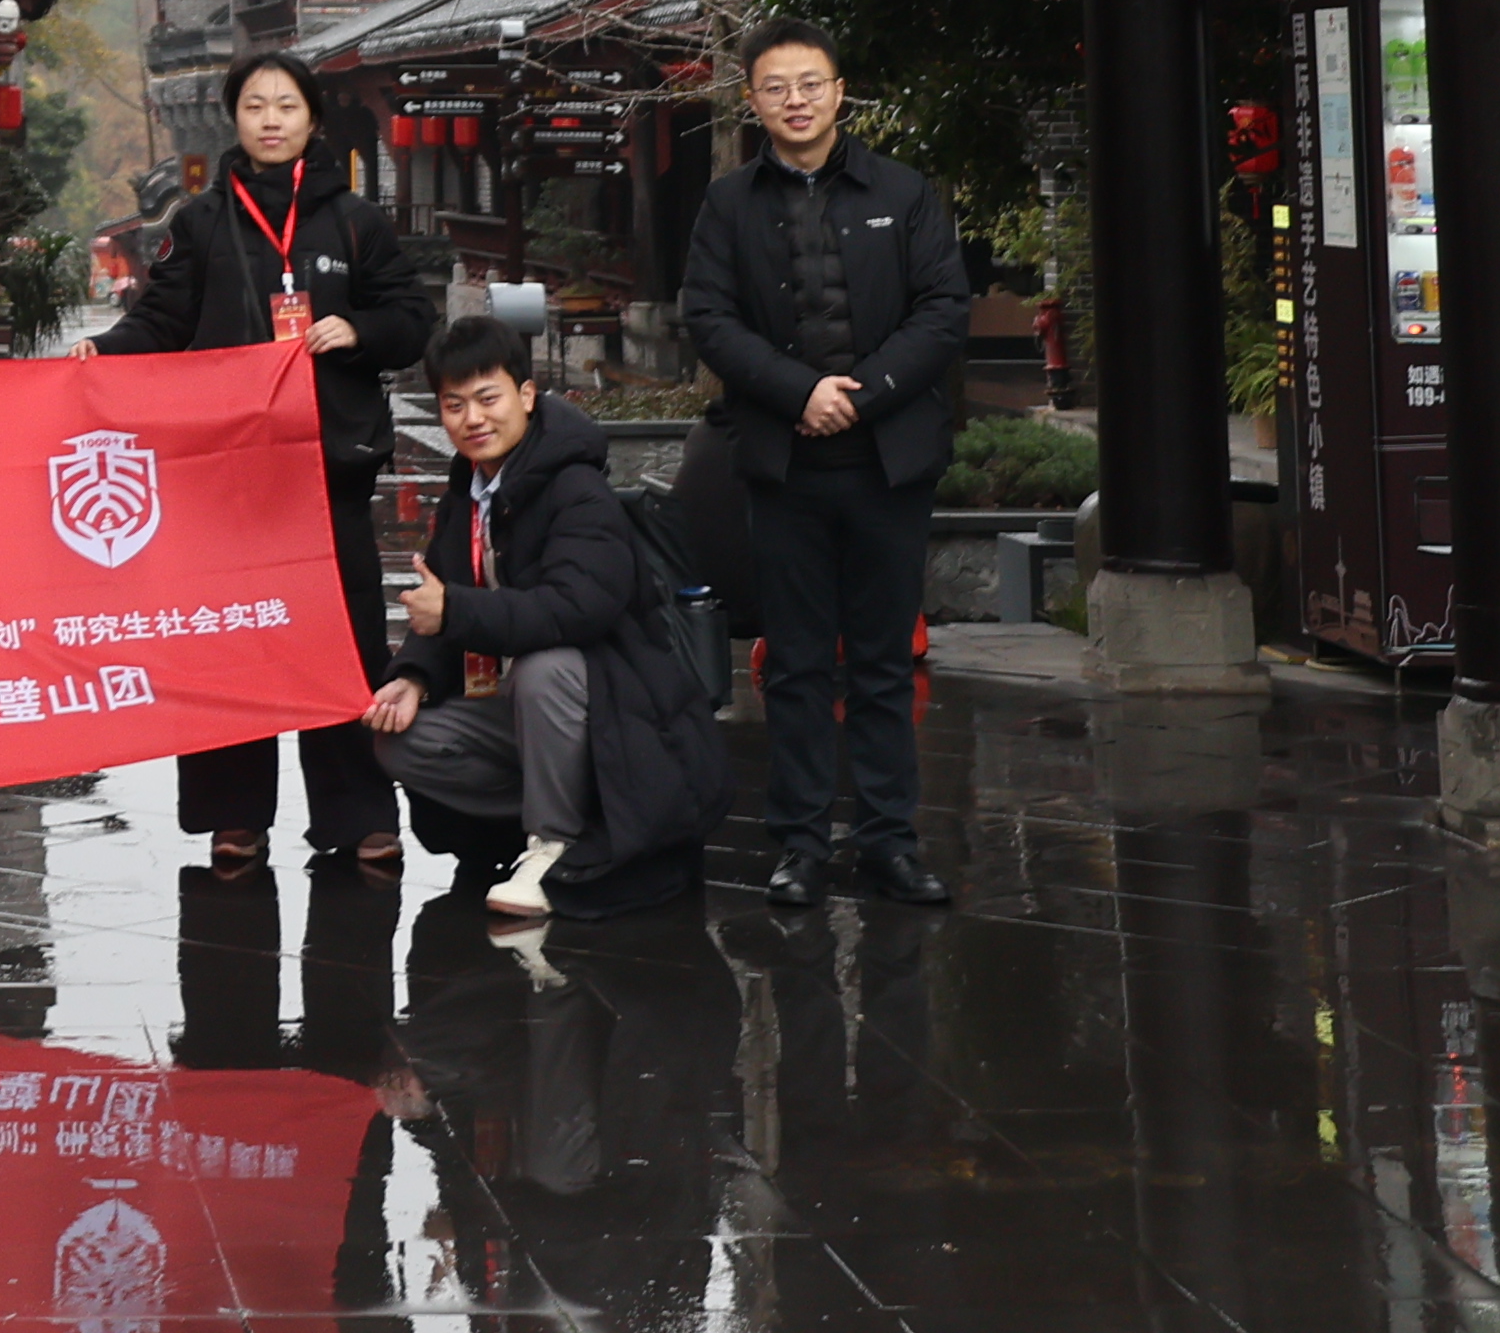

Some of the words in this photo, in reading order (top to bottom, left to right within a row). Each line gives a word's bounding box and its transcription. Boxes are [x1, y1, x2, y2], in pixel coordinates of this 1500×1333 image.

[1407, 364, 1445, 386] 如遇
[79, 435, 122, 449] 1000+
[53, 597, 291, 648] 研究生社会实践
